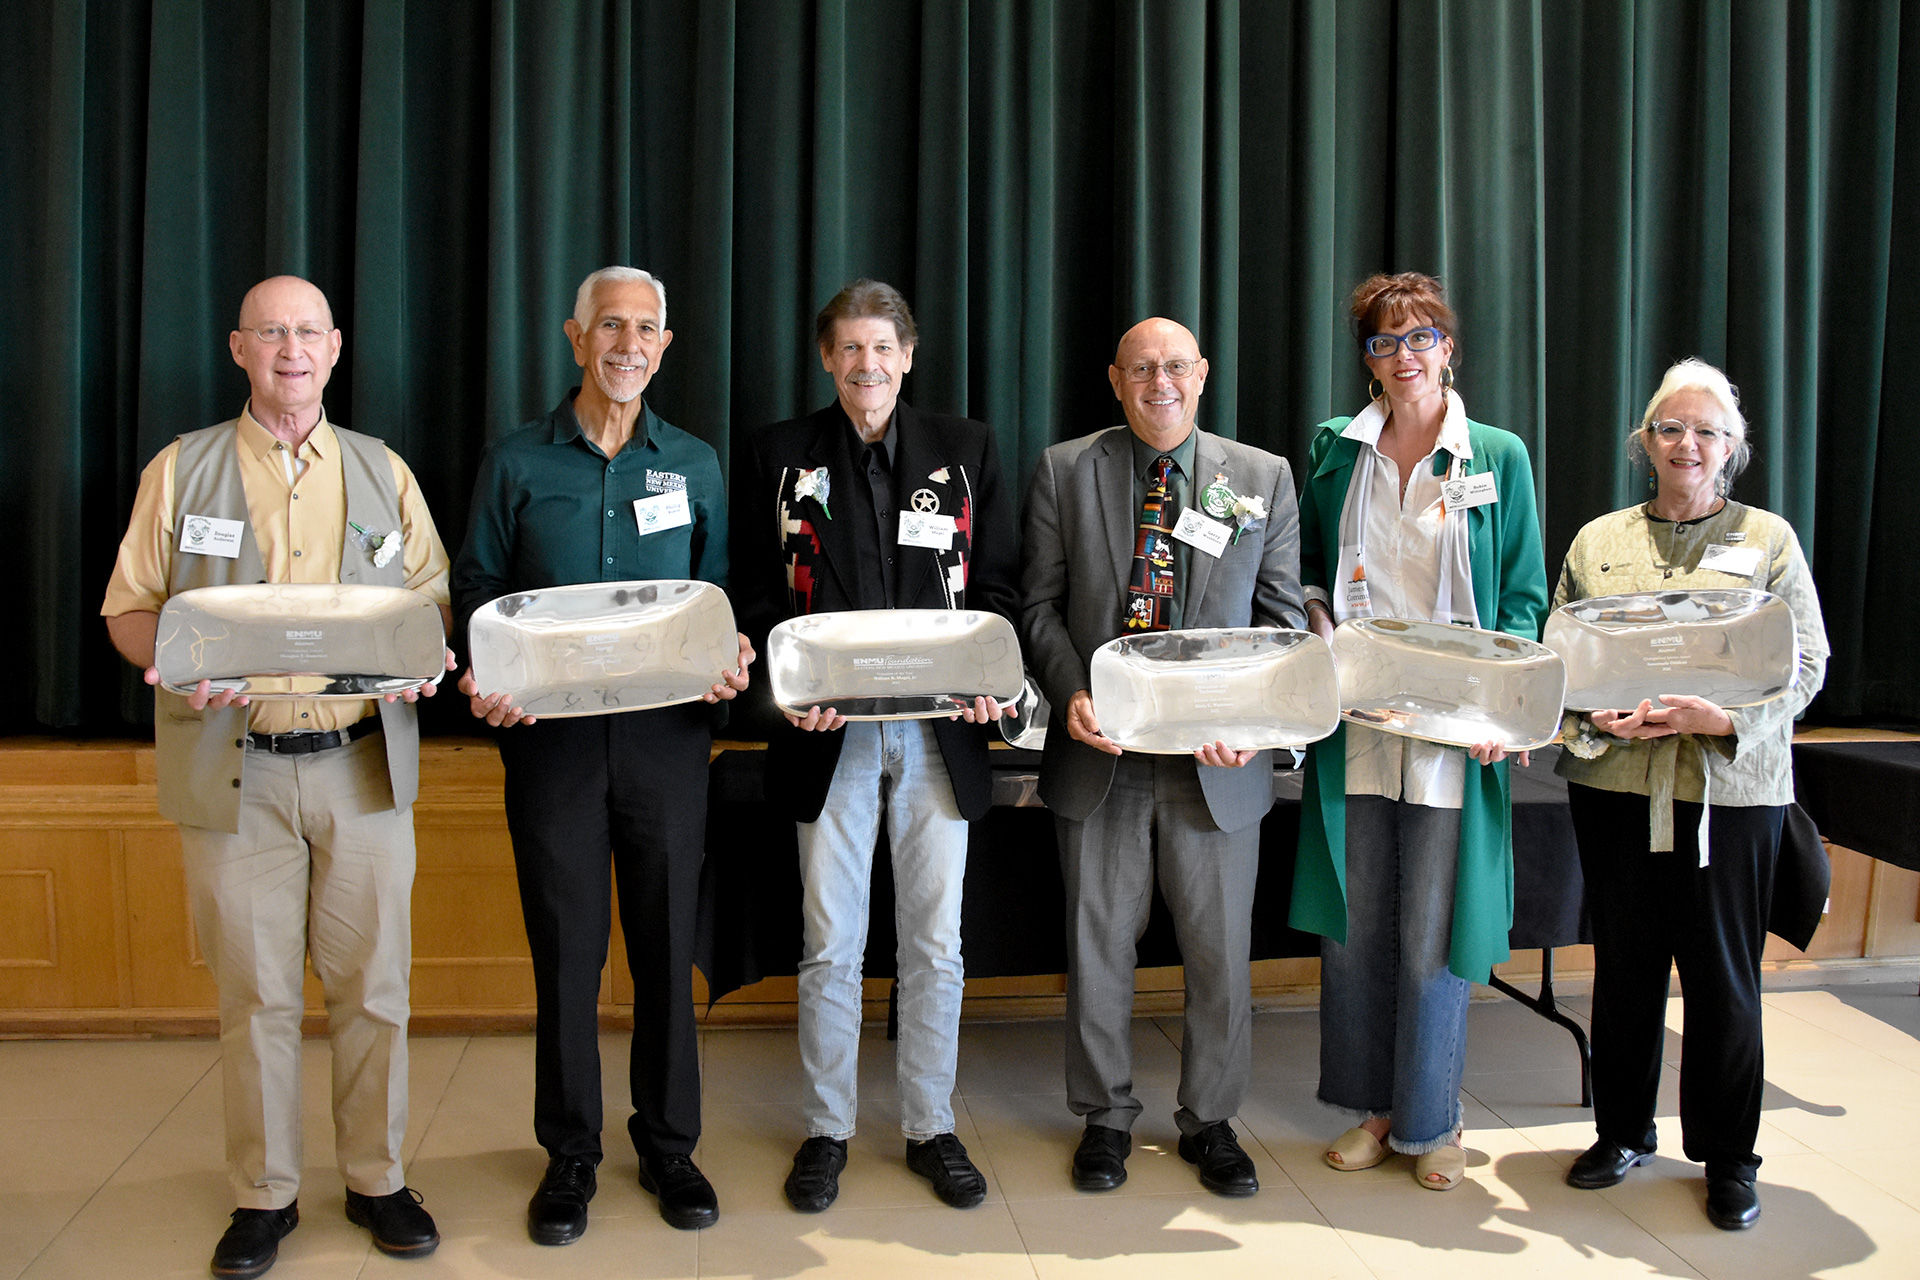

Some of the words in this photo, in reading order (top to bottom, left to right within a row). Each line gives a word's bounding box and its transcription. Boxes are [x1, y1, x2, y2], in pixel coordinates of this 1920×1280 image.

[645, 468, 687, 483] EASTERN
[645, 478, 662, 486] NEW
[928, 524, 949, 532] William
[214, 530, 236, 539] Douglas
[1347, 585, 1365, 593] James
[285, 630, 323, 638] ENMU
[586, 633, 621, 643] ENMU
[1651, 635, 1684, 645] ENMU
[852, 657, 885, 665] ENMU
[885, 654, 934, 666] Foundation
